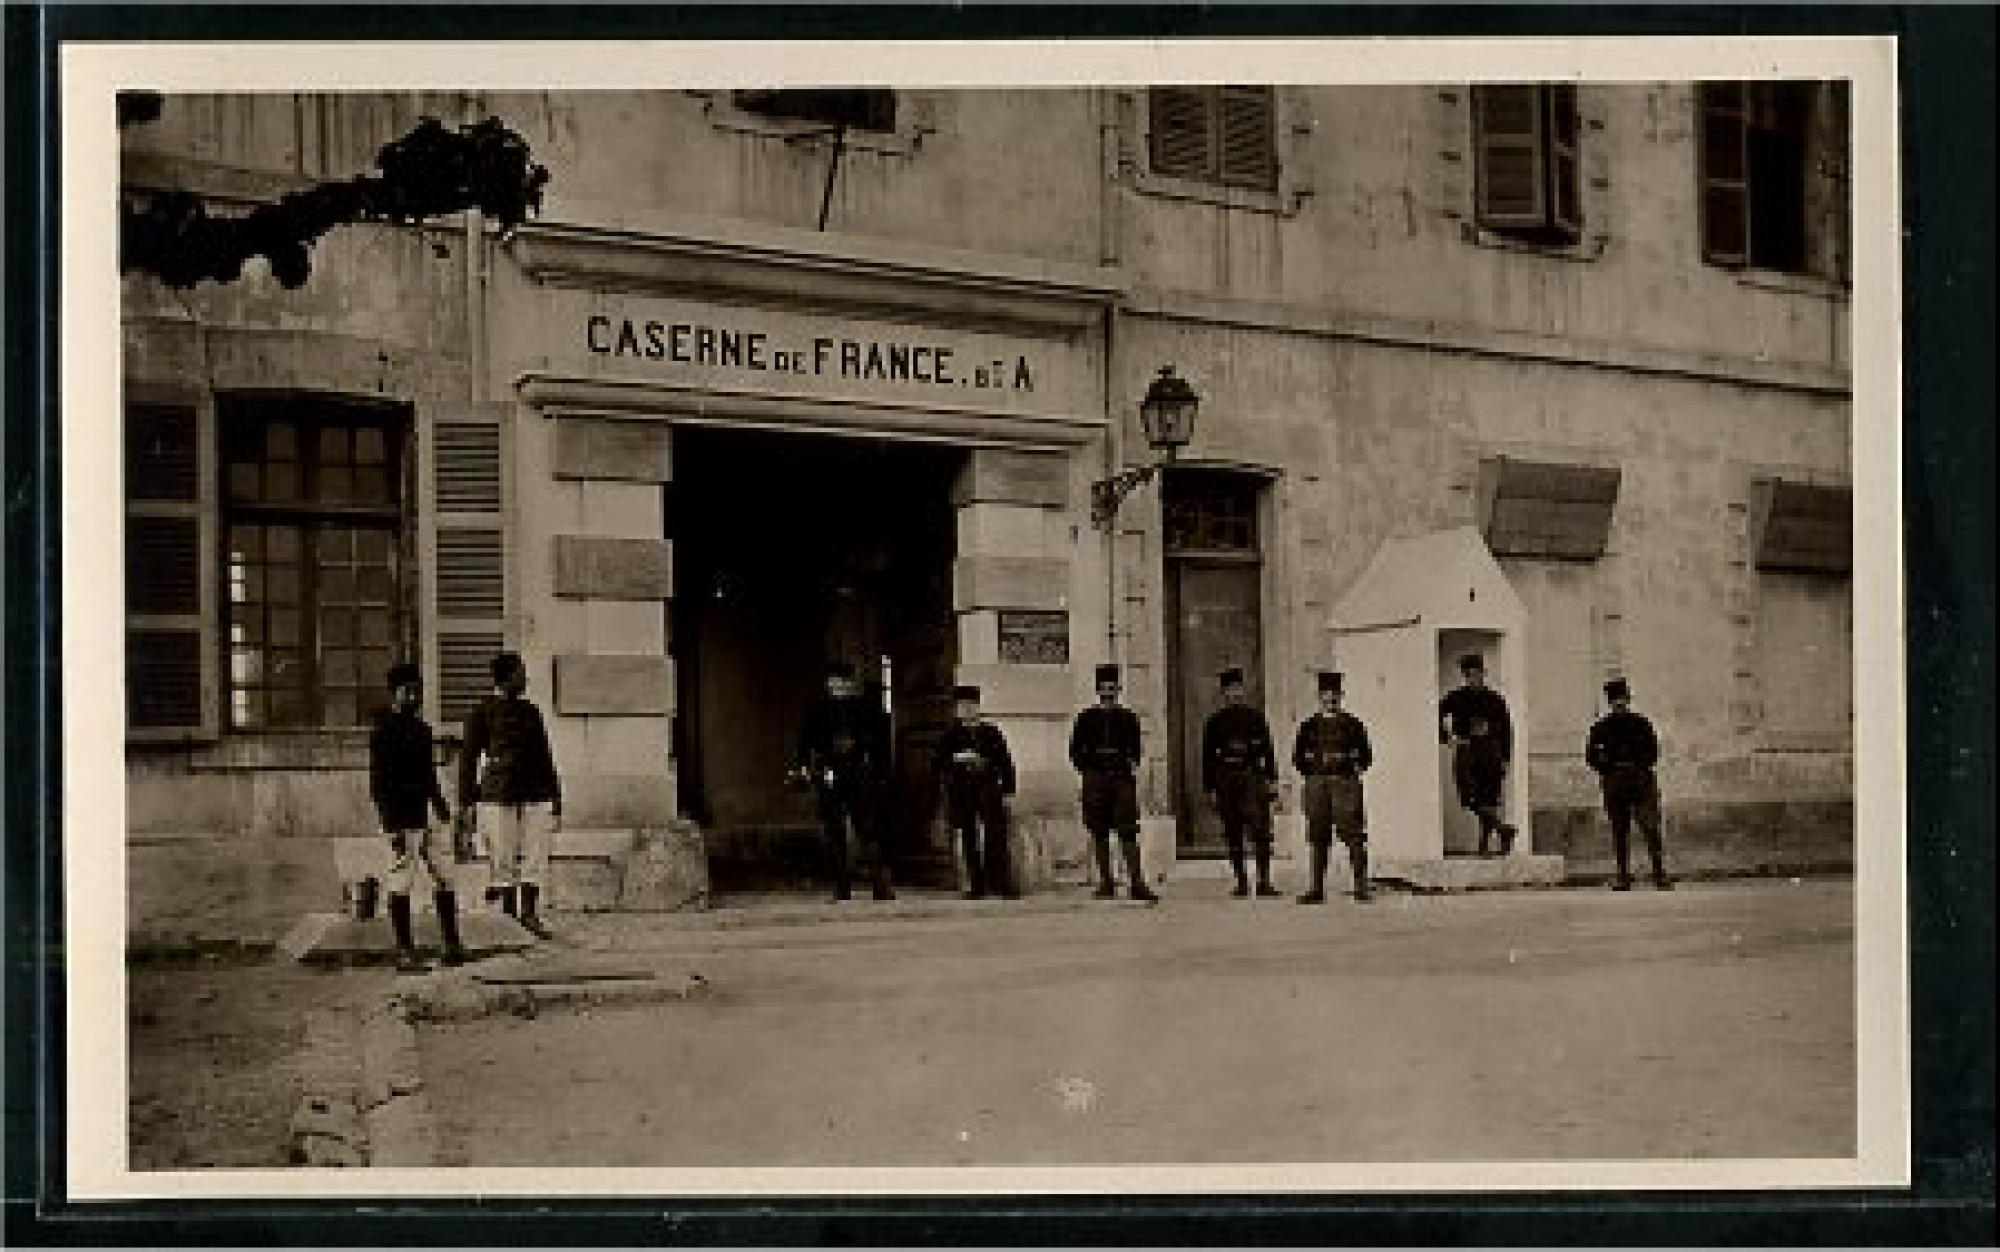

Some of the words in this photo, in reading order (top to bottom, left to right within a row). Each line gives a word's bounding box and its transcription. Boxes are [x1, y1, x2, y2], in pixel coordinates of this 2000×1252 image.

[587, 315, 767, 371] CASERNE
[774, 351, 807, 374] DE
[1013, 355, 1033, 392] A
